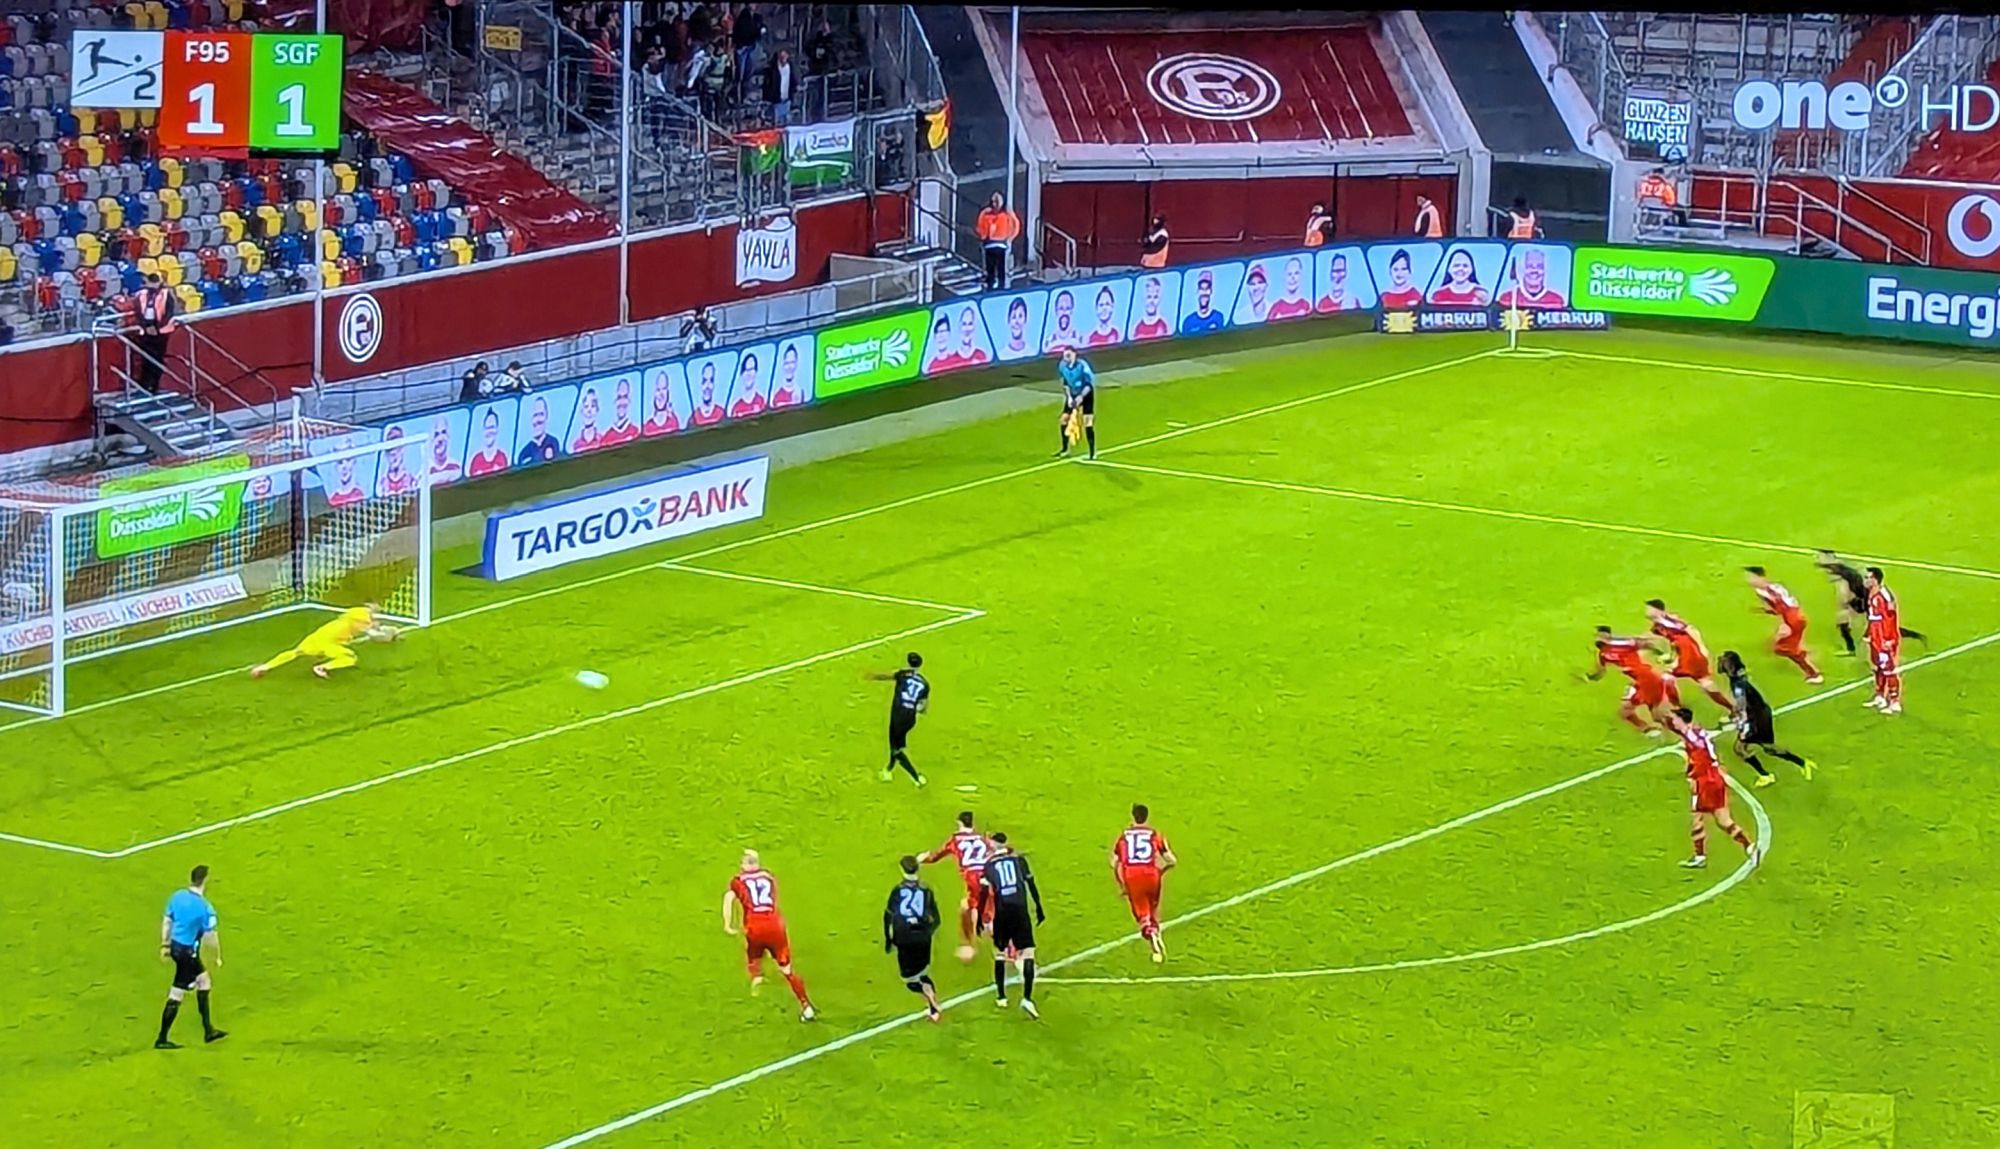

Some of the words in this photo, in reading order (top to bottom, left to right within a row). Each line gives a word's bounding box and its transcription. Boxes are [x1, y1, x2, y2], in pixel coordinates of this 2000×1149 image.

[1627, 100, 1688, 122] GUNZEN
[1625, 120, 1688, 144] HAUSEN
[742, 236, 791, 277] YAYLA
[1590, 262, 1684, 284] Stadtwerke
[1589, 279, 1684, 301] Düsseldorf
[1421, 312, 1488, 328] MERKUR
[1537, 311, 1606, 326] MERKUR
[957, 838, 988, 867] 22
[1125, 833, 1152, 861] 15
[994, 860, 1018, 888] 10
[745, 877, 774, 906] 12
[899, 887, 925, 917] 24
